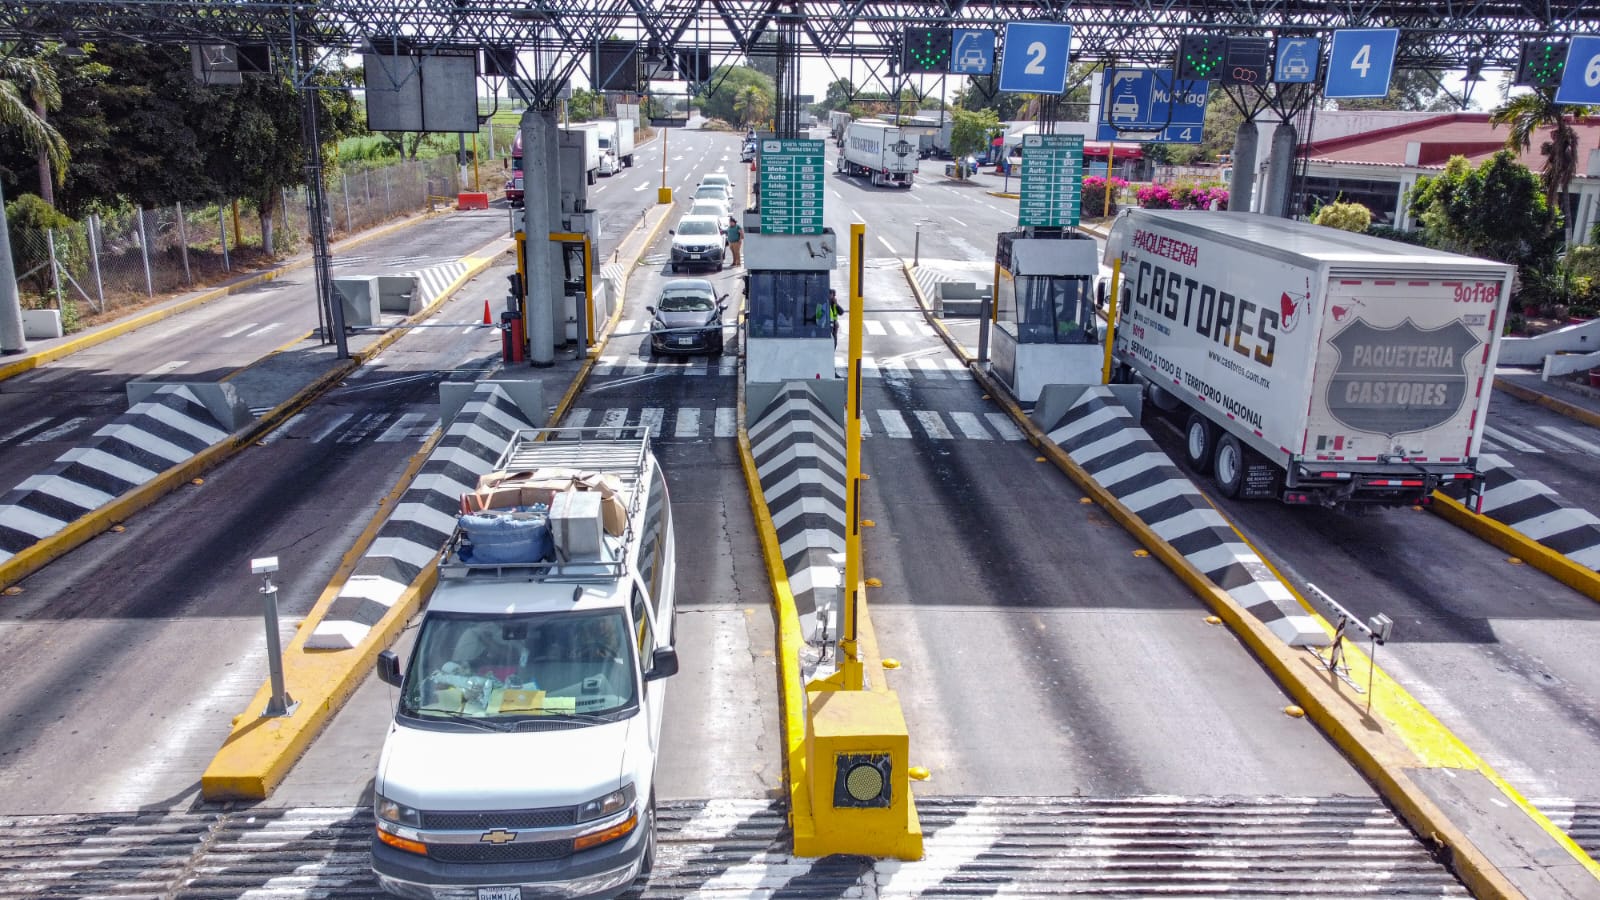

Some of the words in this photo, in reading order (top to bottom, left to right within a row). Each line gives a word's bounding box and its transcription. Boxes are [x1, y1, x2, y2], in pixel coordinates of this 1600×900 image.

[1024, 41, 1047, 75] 2
[1350, 44, 1372, 78] 4
[1584, 53, 1600, 88] 6
[1180, 127, 1192, 141] 4
[1133, 229, 1199, 267] PAQUETERIA
[1454, 287, 1495, 303] 90118
[1136, 260, 1279, 367] CASTORES
[1208, 350, 1271, 390] www.castores.com.mx
[1352, 345, 1454, 368] PAQUETERIA
[1130, 340, 1153, 361] SERVICIO
[1158, 356, 1175, 375] TODO
[1175, 366, 1182, 380] EL
[1184, 372, 1221, 403] TERRITORIO
[1222, 394, 1263, 429] NACIONAL
[1345, 381, 1448, 405] CASTORES
